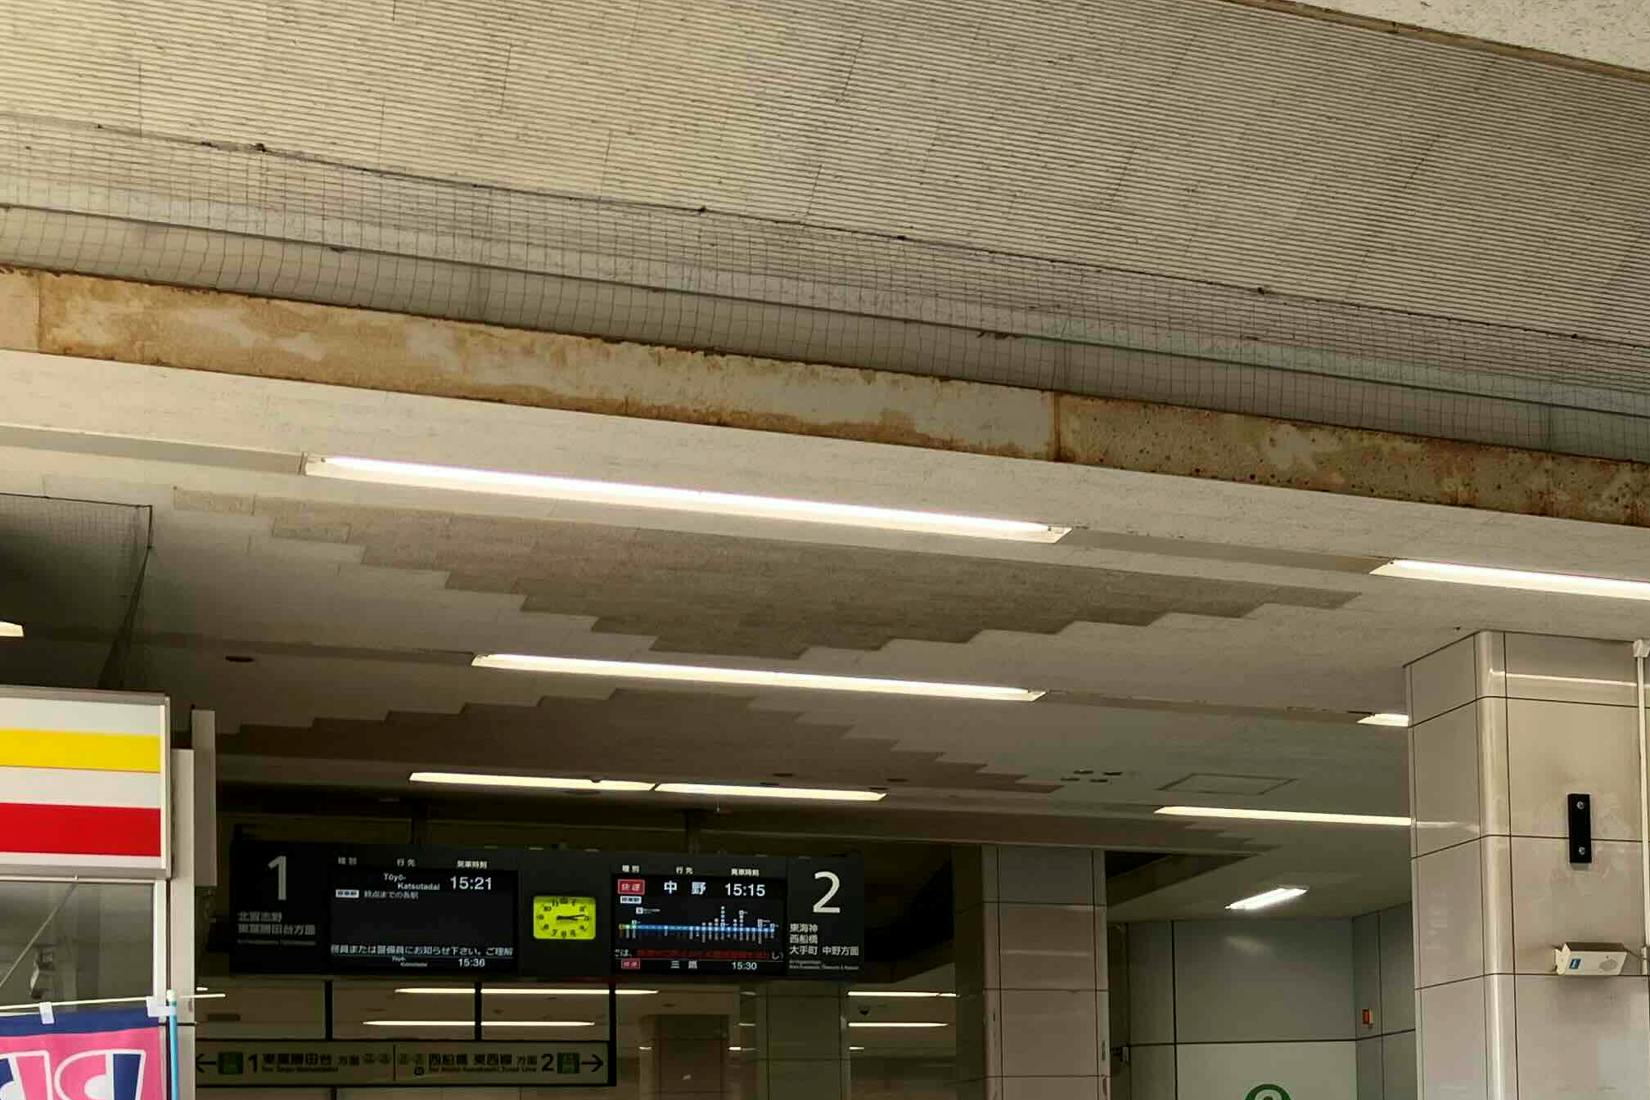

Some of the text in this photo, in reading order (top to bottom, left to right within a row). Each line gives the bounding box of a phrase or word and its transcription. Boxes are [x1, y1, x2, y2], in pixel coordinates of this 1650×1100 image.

[267, 855, 287, 901] 1
[450, 876, 492, 891] 15:21
[725, 883, 766, 897] 15:15
[813, 871, 841, 913] 2
[540, 1053, 555, 1073] 2
